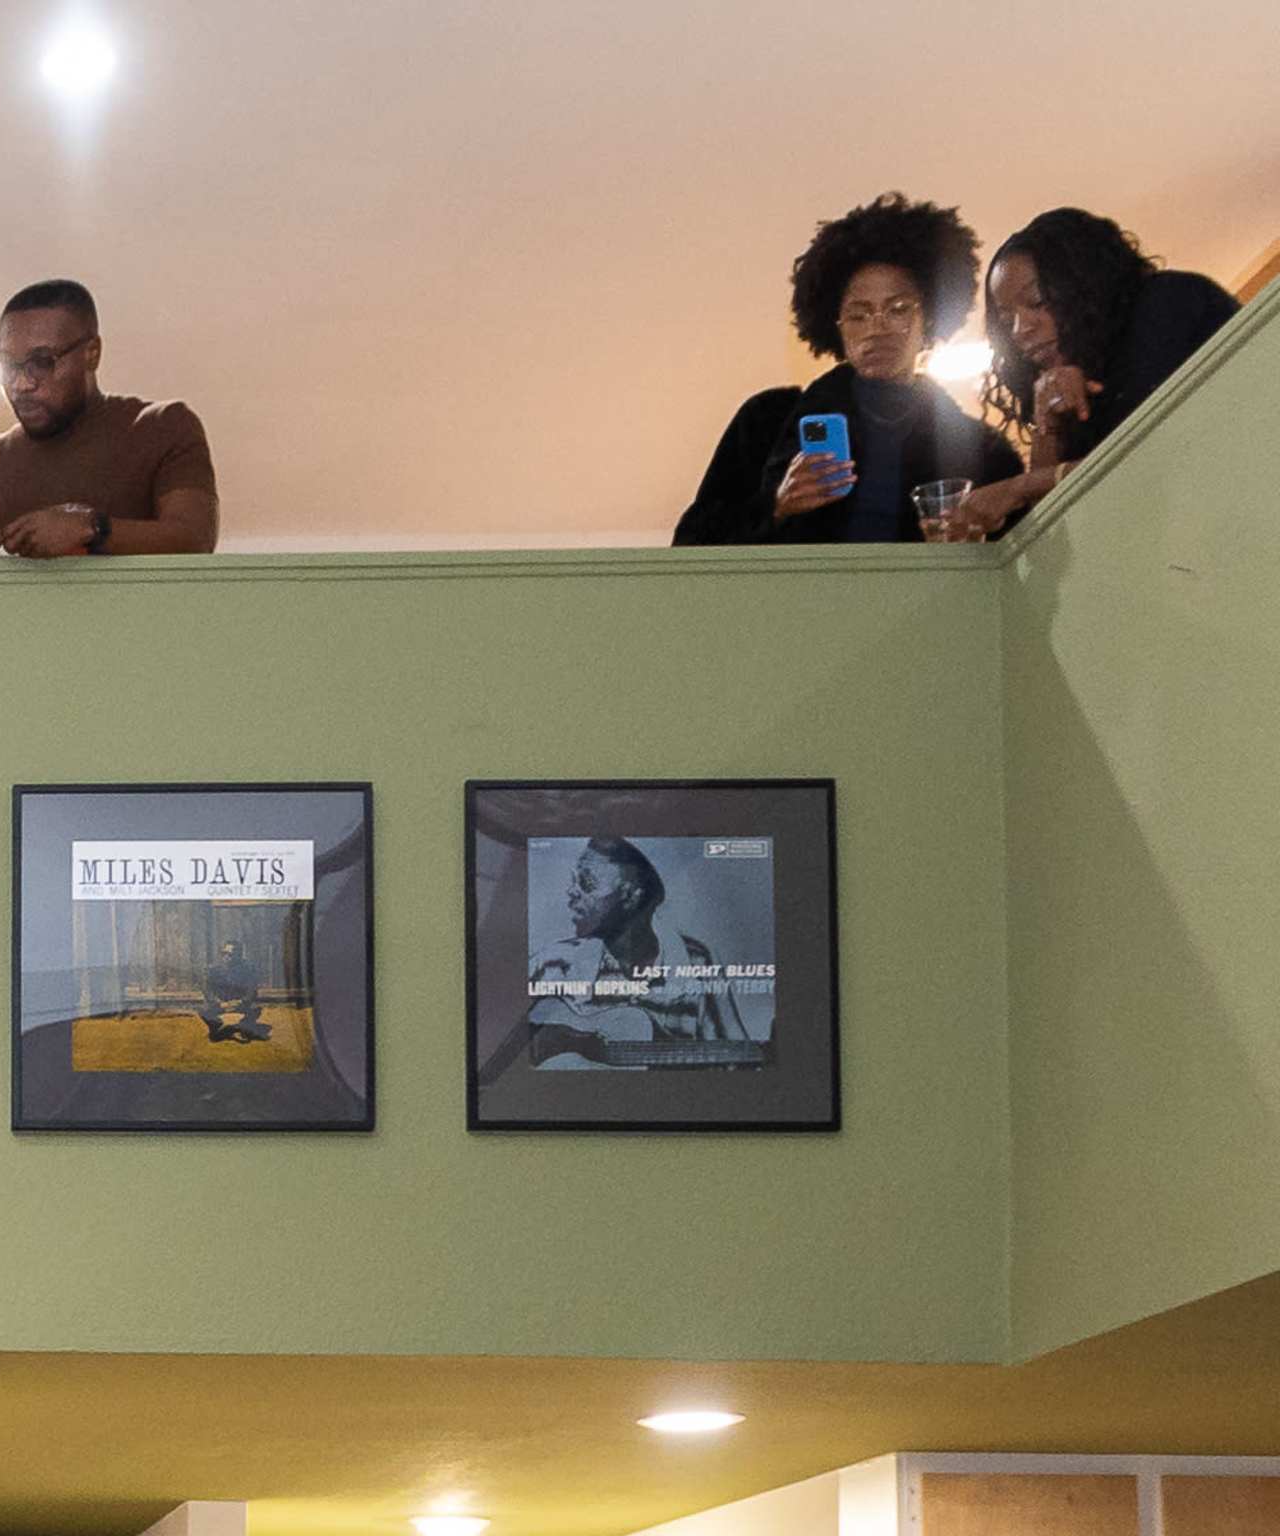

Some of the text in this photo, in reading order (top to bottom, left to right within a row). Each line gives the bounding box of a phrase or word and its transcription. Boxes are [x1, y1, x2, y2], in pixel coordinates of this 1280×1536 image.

[79, 857, 287, 886] MILES DAVIS
[138, 886, 185, 896] JACKSON
[207, 886, 251, 896] QUINTET
[633, 964, 776, 978] LAST NIGHT BLUES
[595, 980, 650, 996] HOPKINS
